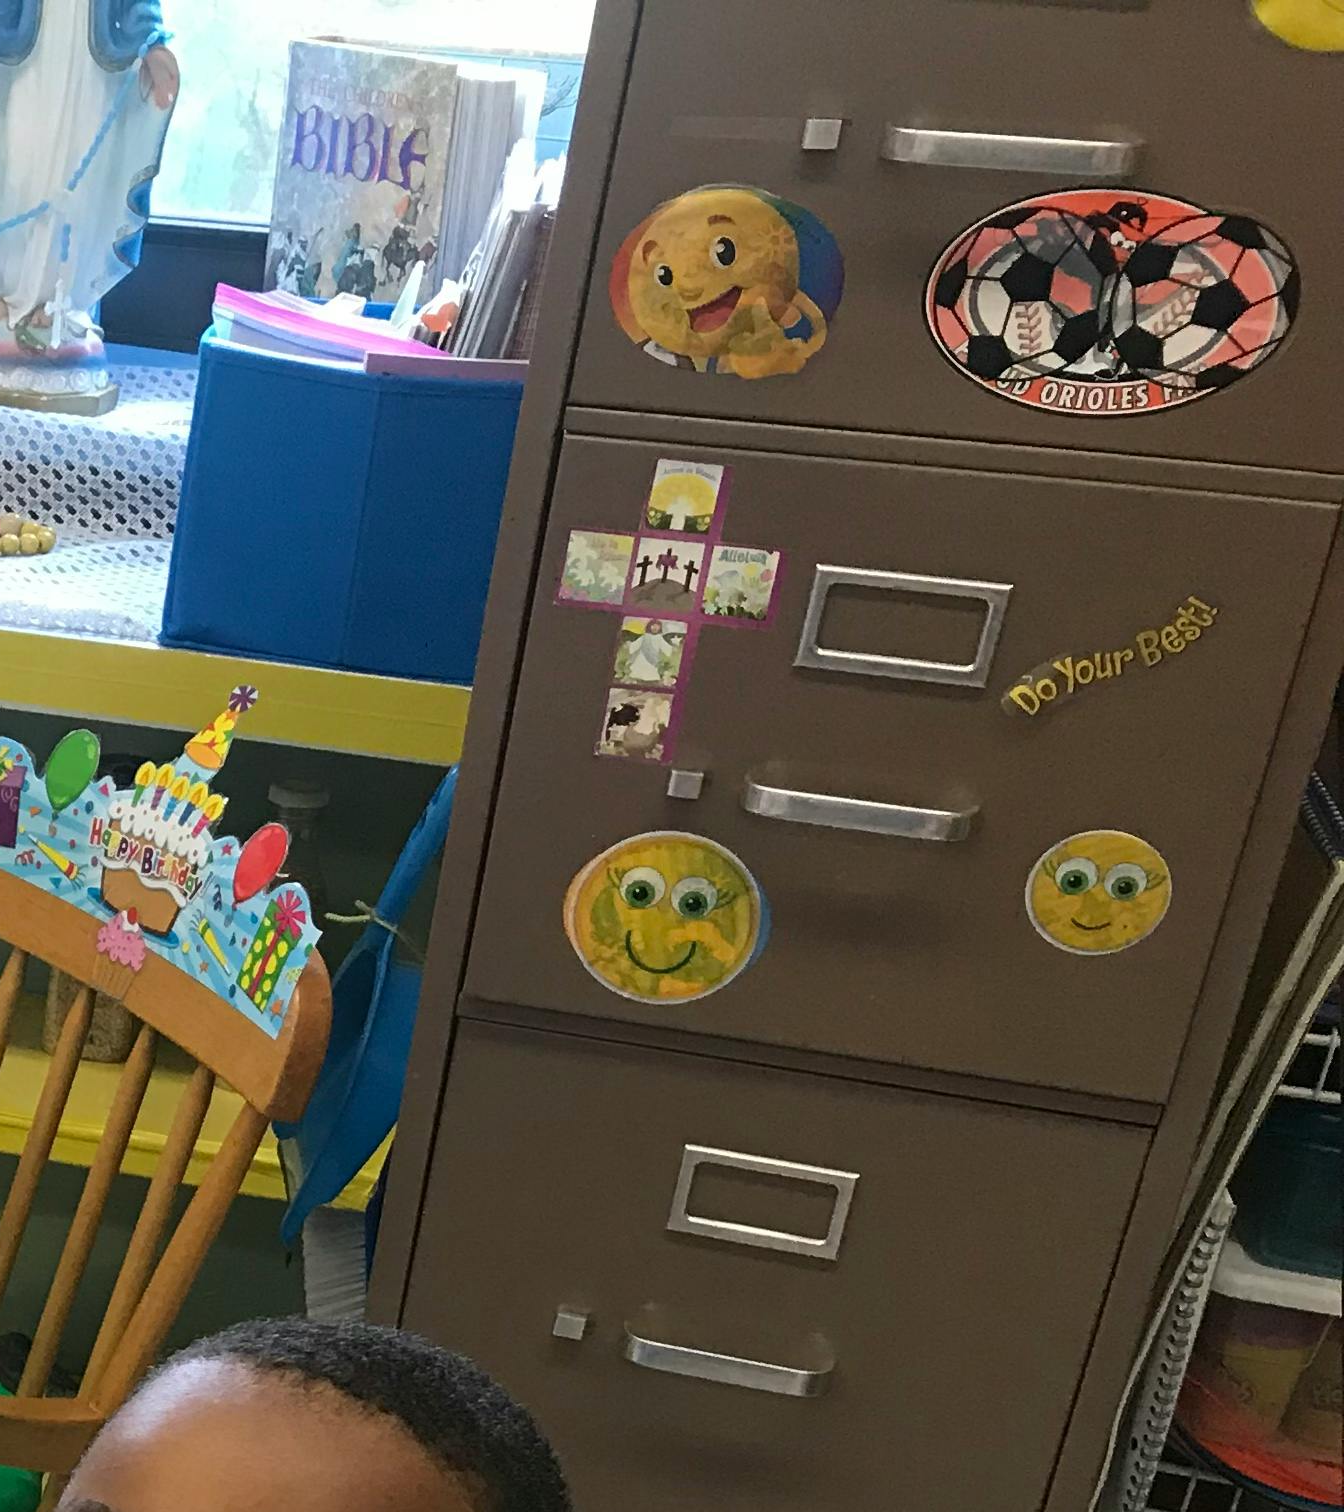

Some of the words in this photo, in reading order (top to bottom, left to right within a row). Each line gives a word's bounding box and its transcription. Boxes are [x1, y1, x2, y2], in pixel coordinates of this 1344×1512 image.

[290, 104, 430, 194] BIBLE
[1040, 383, 1150, 411] ORIOLES
[1009, 677, 1058, 716] Do
[1052, 647, 1134, 694] Your
[1136, 595, 1219, 668] Best!
[89, 816, 141, 866] Happy
[140, 844, 204, 901] Birthday
